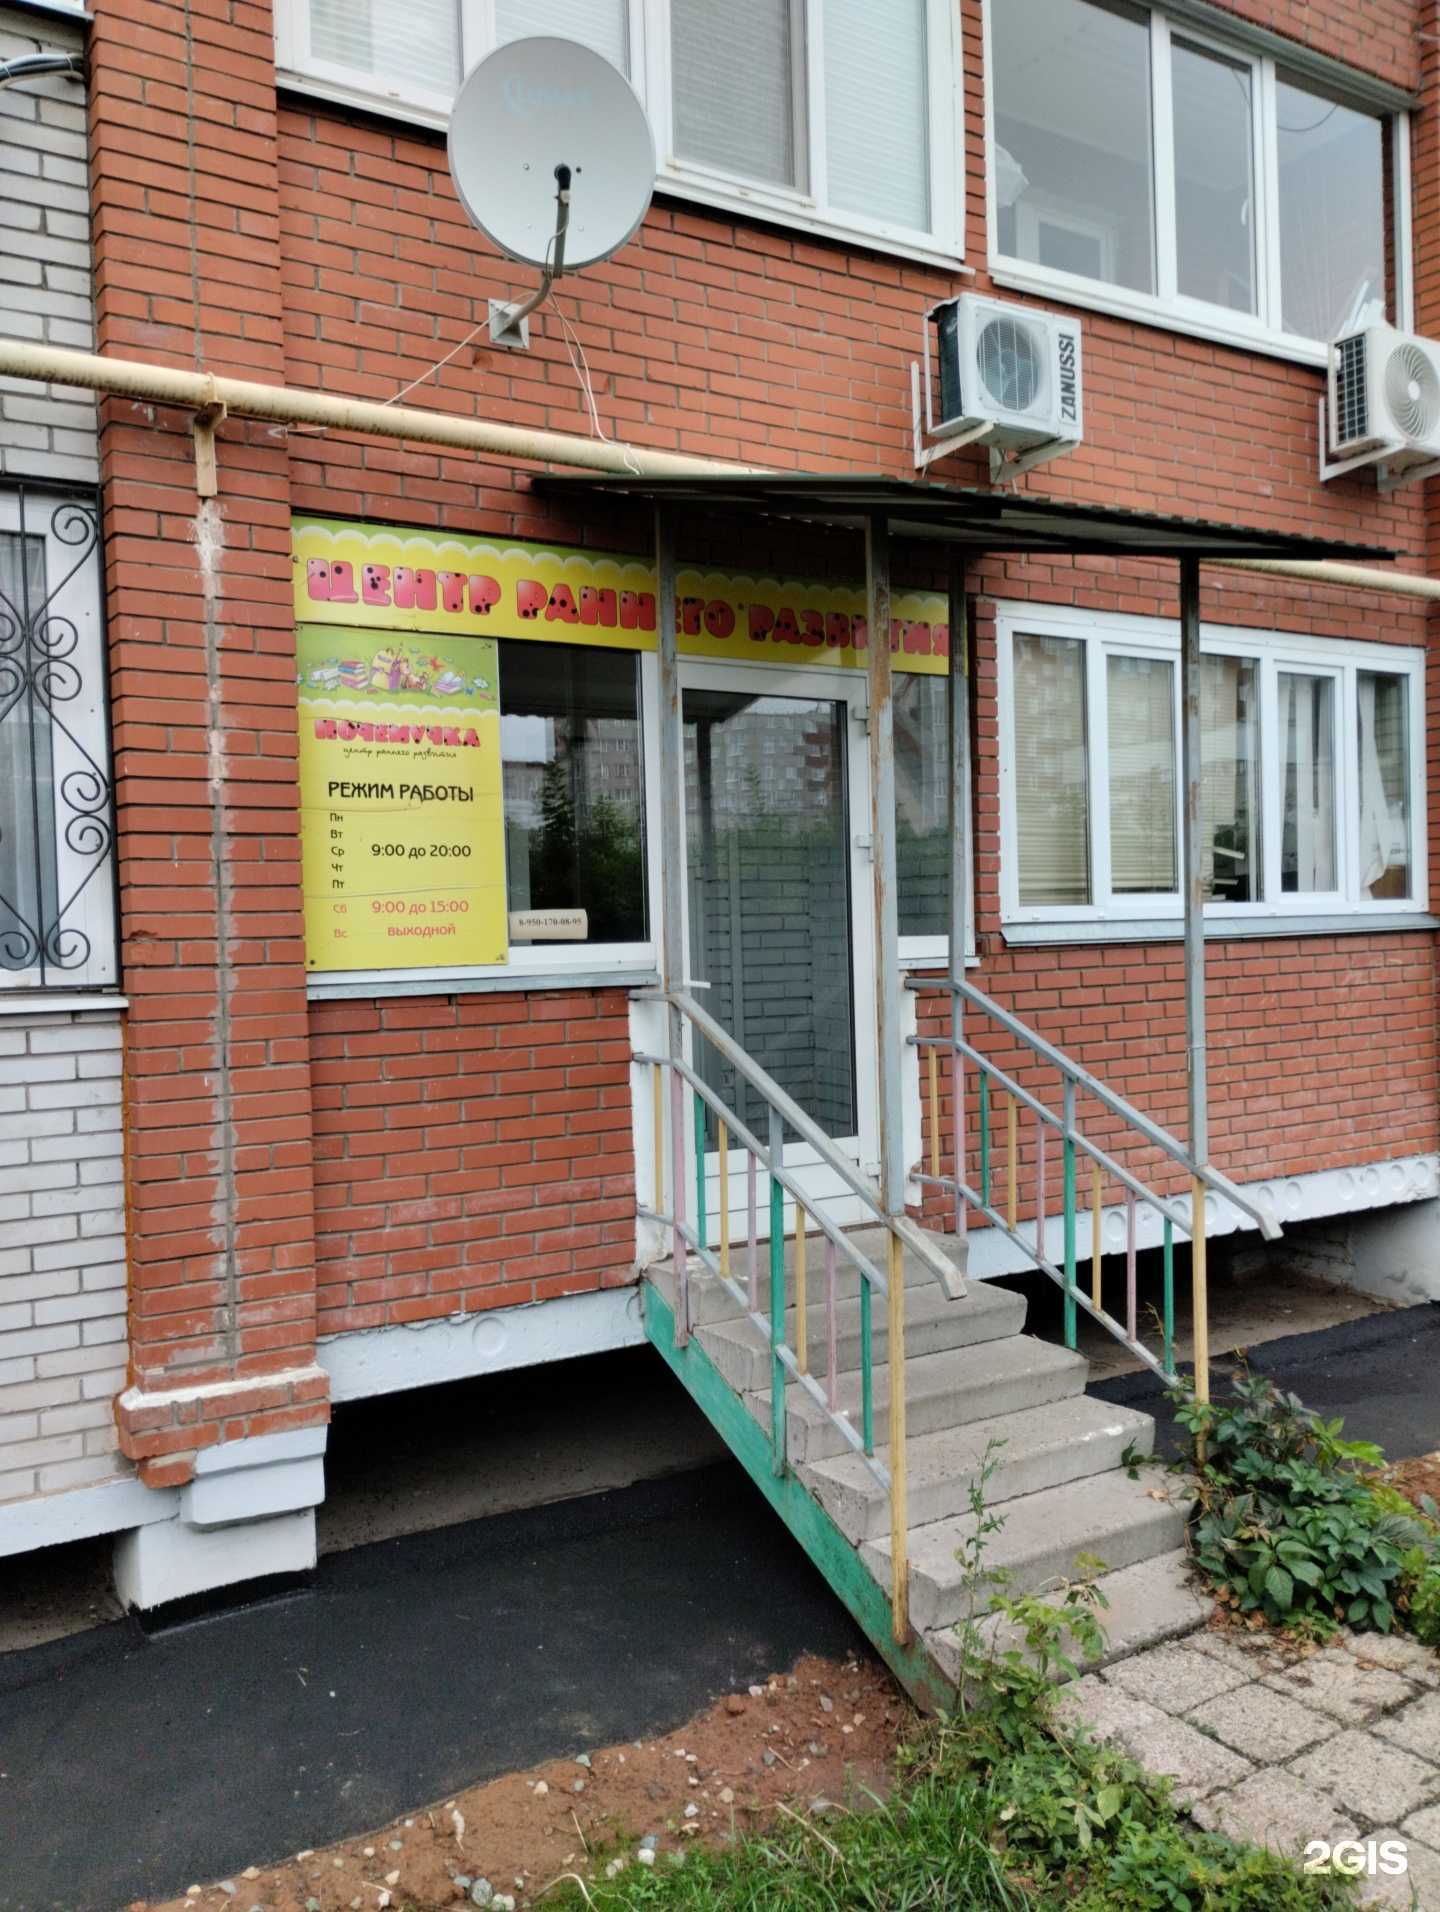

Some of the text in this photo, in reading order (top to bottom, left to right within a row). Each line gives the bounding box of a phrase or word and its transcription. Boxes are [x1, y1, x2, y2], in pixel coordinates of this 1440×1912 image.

[1059, 333, 1076, 422] ZANUSSI
[307, 559, 501, 616] ЦЕНТР
[516, 579, 736, 639] РАННГО
[314, 719, 481, 748] ПОЧЕМУЧКА
[328, 781, 474, 802] РЕЖИМ РАБОТЫ
[330, 813, 343, 822] Пн
[330, 829, 343, 839] Вт
[331, 846, 345, 857] Ср
[371, 844, 471, 859] 9:00 до 20:00
[331, 863, 343, 872] Чт
[332, 879, 345, 888] Пт
[333, 900, 469, 915] Сб 9:00 до 15:00
[334, 928, 348, 938] Вс
[387, 923, 456, 938] выходной
